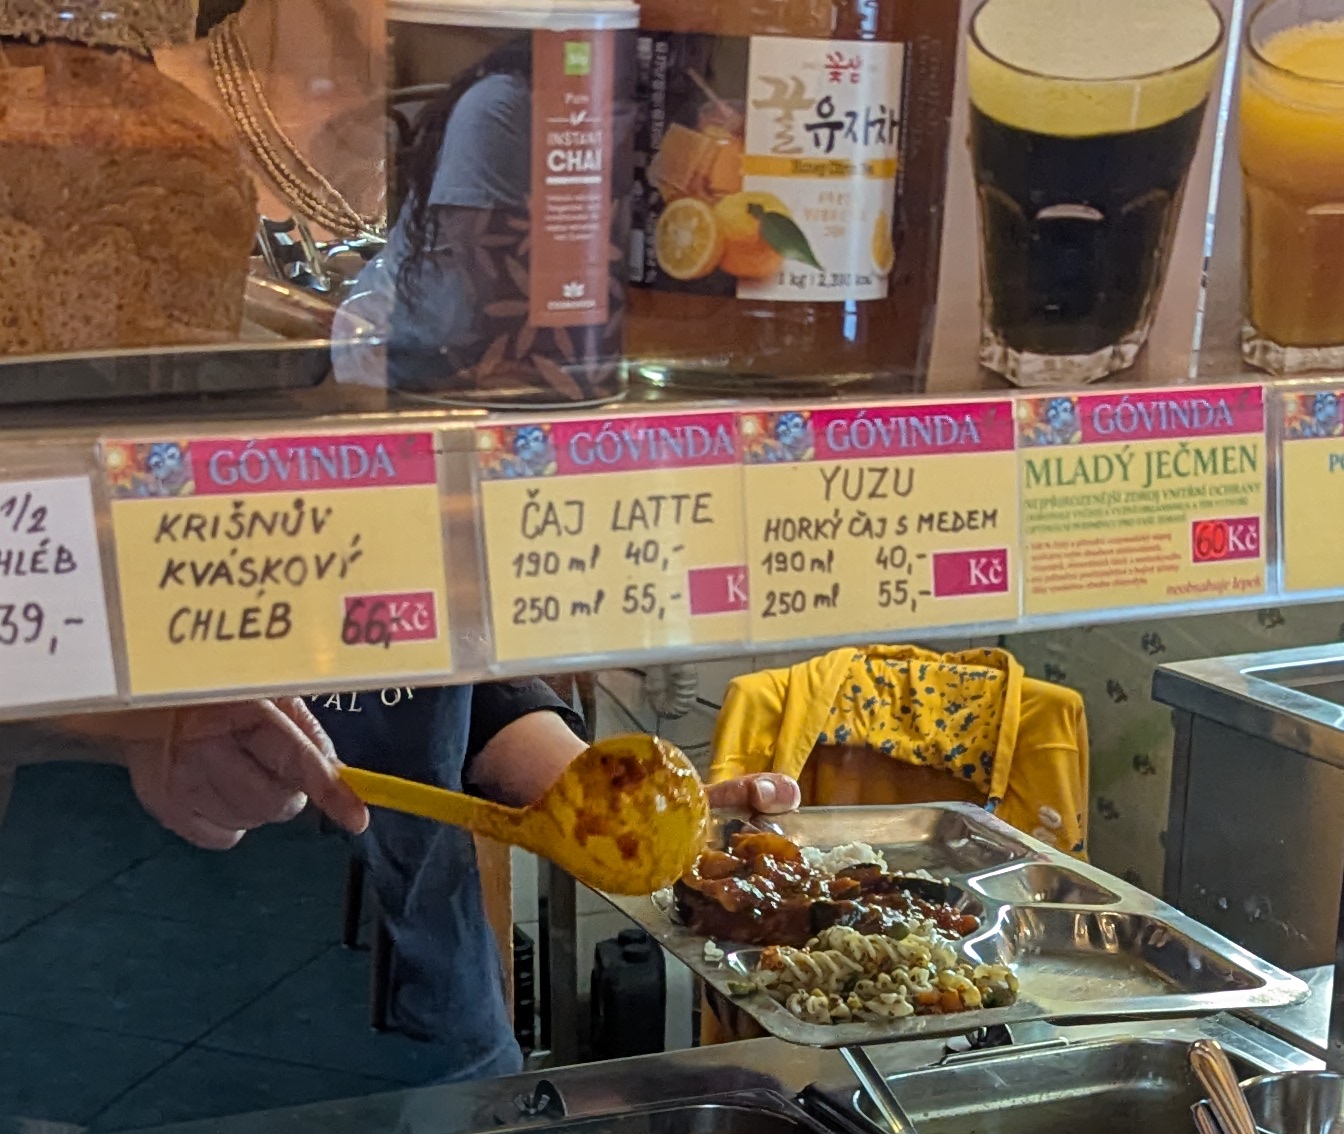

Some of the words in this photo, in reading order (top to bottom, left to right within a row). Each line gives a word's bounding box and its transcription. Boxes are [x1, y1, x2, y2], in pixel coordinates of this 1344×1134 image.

[546, 149, 603, 172] CHAI
[826, 407, 982, 453] GÓVINDA
[1091, 394, 1235, 435] GÓVINDA
[207, 440, 398, 486] GÓVINDA
[568, 420, 736, 467] GÓVINDA
[819, 466, 915, 501] YUZU
[1025, 444, 1135, 489] MLADÝ
[1143, 440, 1258, 488] JEČMEN
[154, 498, 334, 544] KRIŠNŮV
[521, 488, 585, 540] ČAJ
[610, 492, 715, 532] LATTE
[763, 508, 843, 542] HORKÝ
[848, 510, 887, 540] ČAJ
[895, 515, 909, 536] S
[916, 508, 999, 534] MEDEM
[1194, 520, 1228, 560] 60
[1228, 524, 1258, 552] Kč
[159, 534, 364, 590] KVÁSKOVÝ
[512, 551, 560, 579] 190
[568, 543, 601, 573] ml
[761, 551, 806, 576] 190
[810, 549, 835, 574] ml
[967, 557, 1003, 586] Kč
[512, 596, 560, 625] 250
[570, 589, 606, 617] ml
[726, 573, 748, 604] K
[761, 590, 806, 619] 250
[812, 582, 840, 609] ml
[167, 588, 294, 644] CHLÉB
